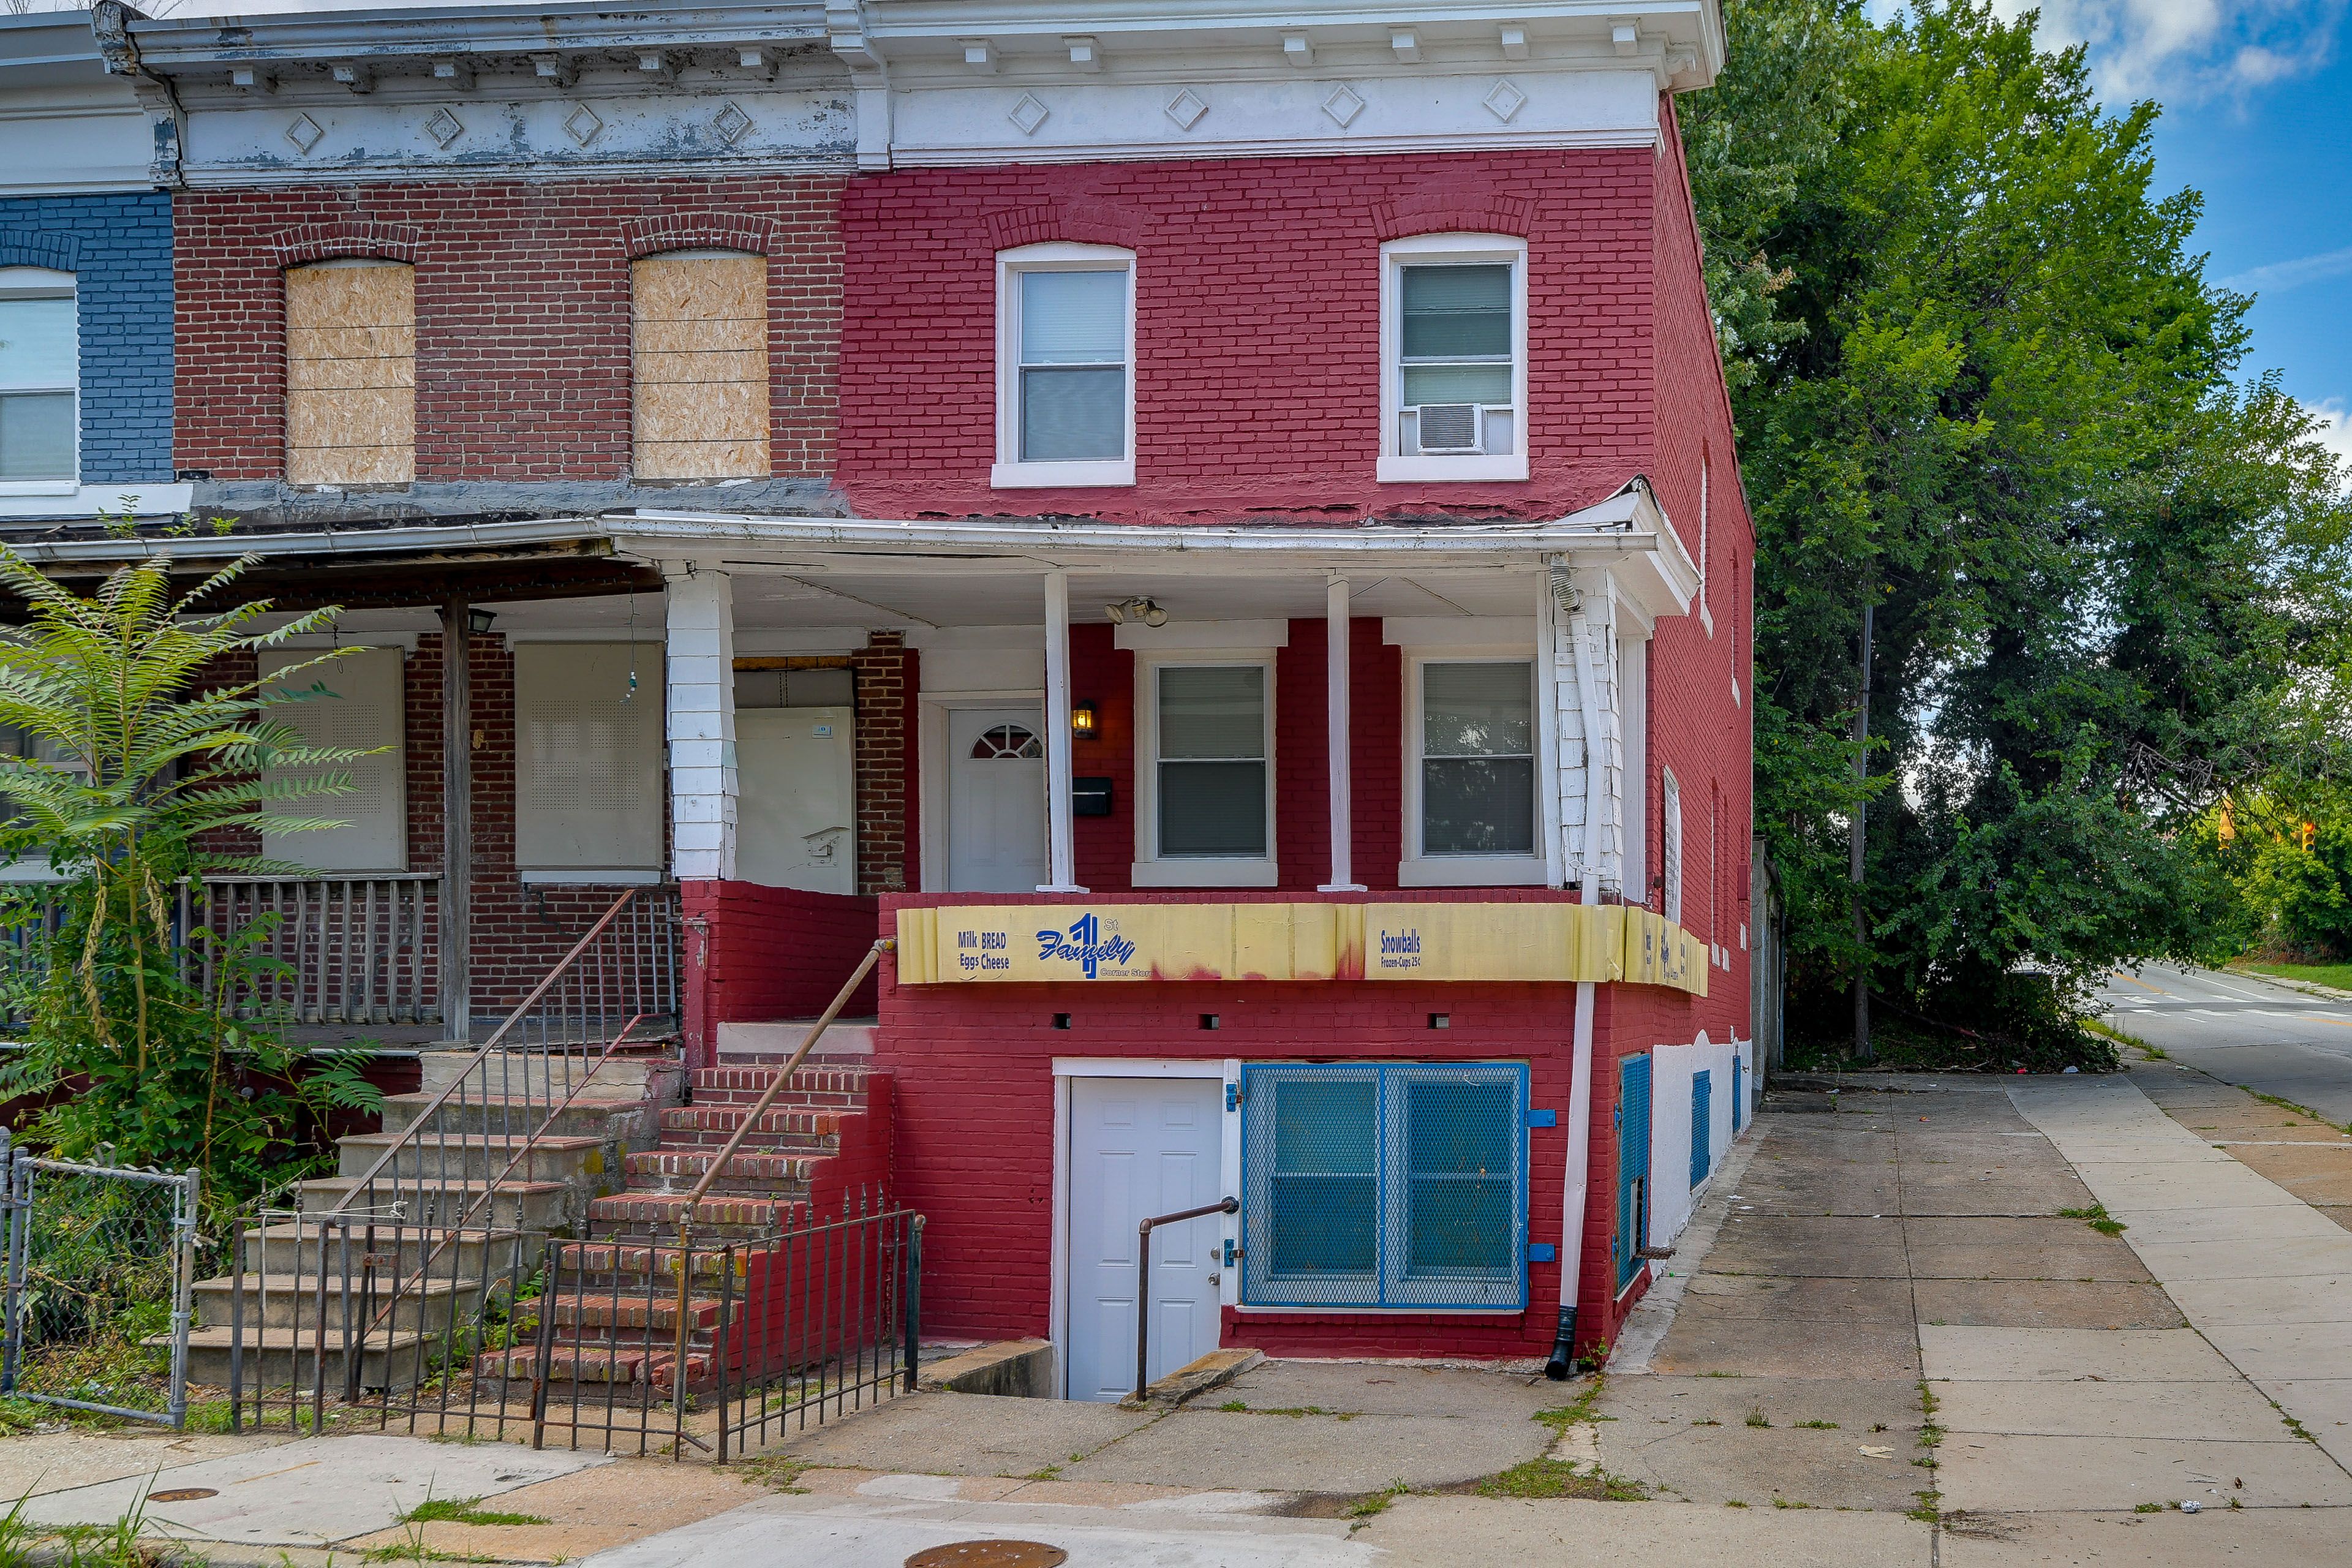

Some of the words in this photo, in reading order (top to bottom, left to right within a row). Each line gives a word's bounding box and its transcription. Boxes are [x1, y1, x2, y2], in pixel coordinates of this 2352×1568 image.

[1104, 919, 1118, 931] St
[958, 930, 978, 948] Milk
[981, 932, 1006, 949] BREAD
[1036, 930, 1136, 965] Family
[1381, 928, 1420, 954] Snowballs
[960, 952, 979, 970] Eggs
[981, 952, 1009, 970] Cheese
[1381, 956, 1411, 971] Frozen-Cups
[1101, 967, 1129, 976] Corner
